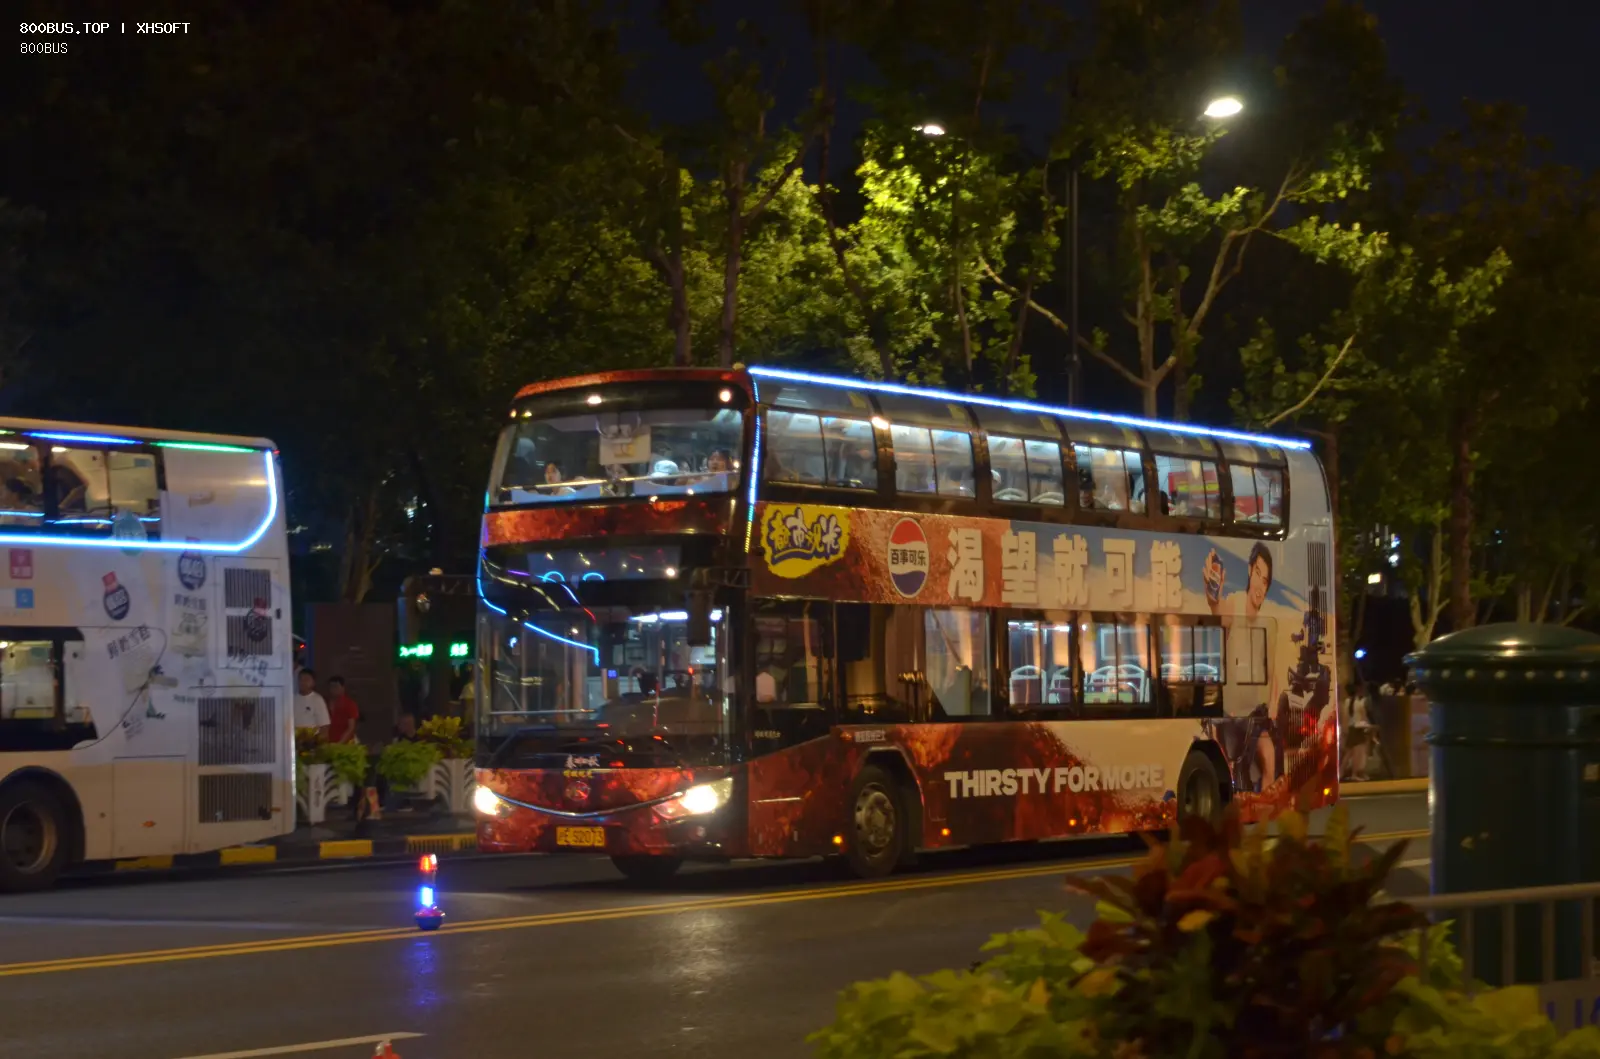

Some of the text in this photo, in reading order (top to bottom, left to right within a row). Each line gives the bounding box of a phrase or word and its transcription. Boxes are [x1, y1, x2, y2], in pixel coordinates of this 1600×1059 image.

[889, 548, 928, 567] 百事可乐
[947, 527, 1183, 610] 渴望就可能
[943, 763, 1166, 799] THIRSTY FOR MORE
